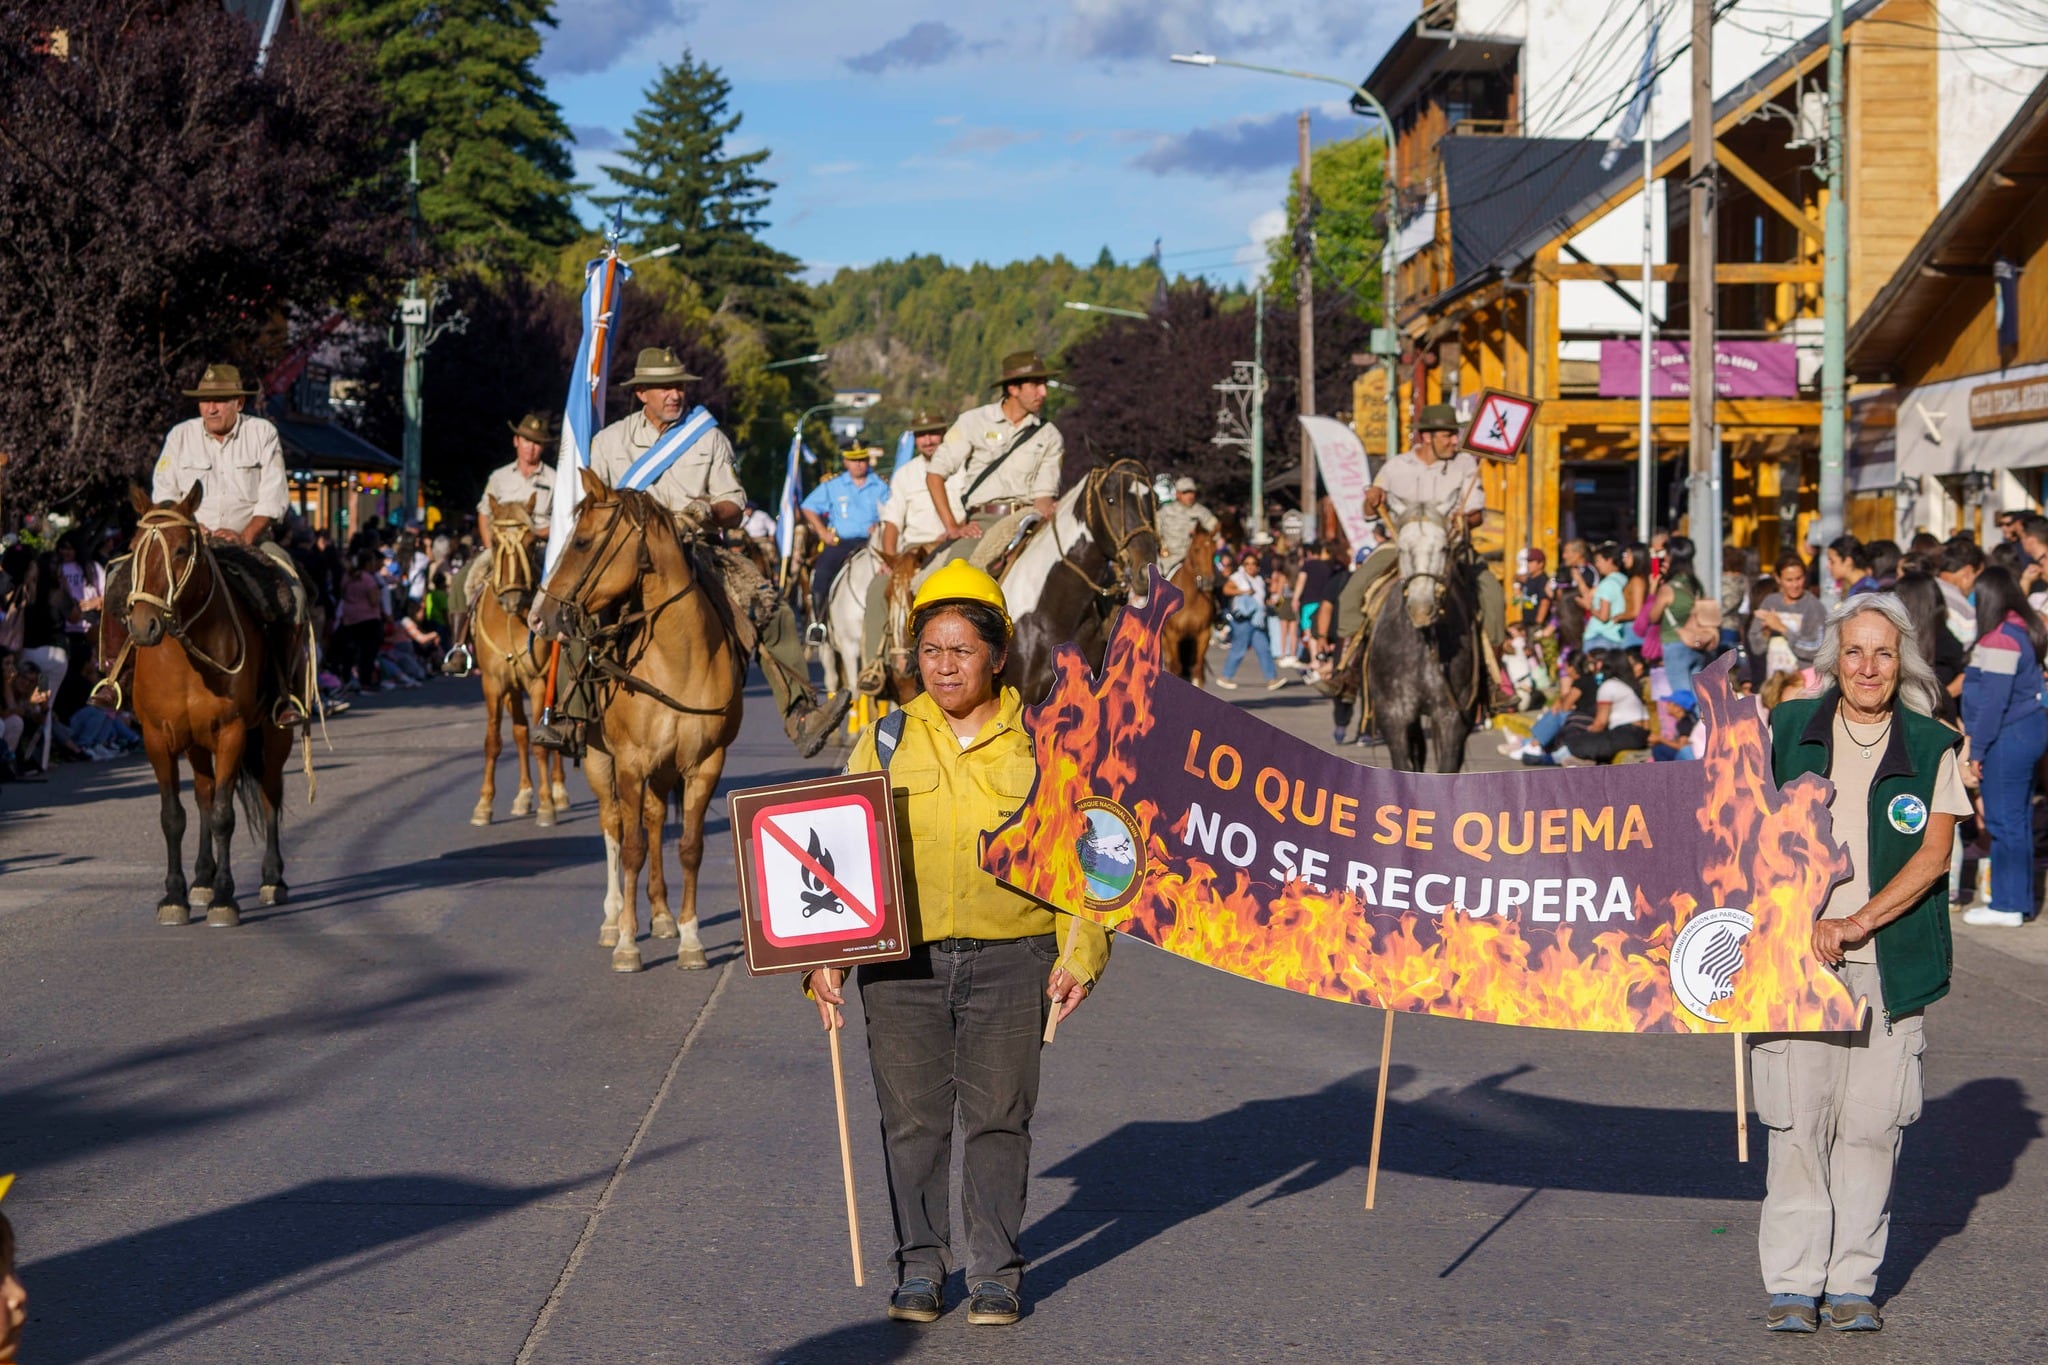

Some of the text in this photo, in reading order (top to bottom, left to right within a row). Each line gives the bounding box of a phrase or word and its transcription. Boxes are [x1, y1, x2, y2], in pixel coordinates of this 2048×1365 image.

[1184, 729, 1654, 863] LO QUE SE QUEMA
[1184, 802, 1636, 923] NO SE RECUPERA
[1719, 911, 1750, 923] PARQUES
